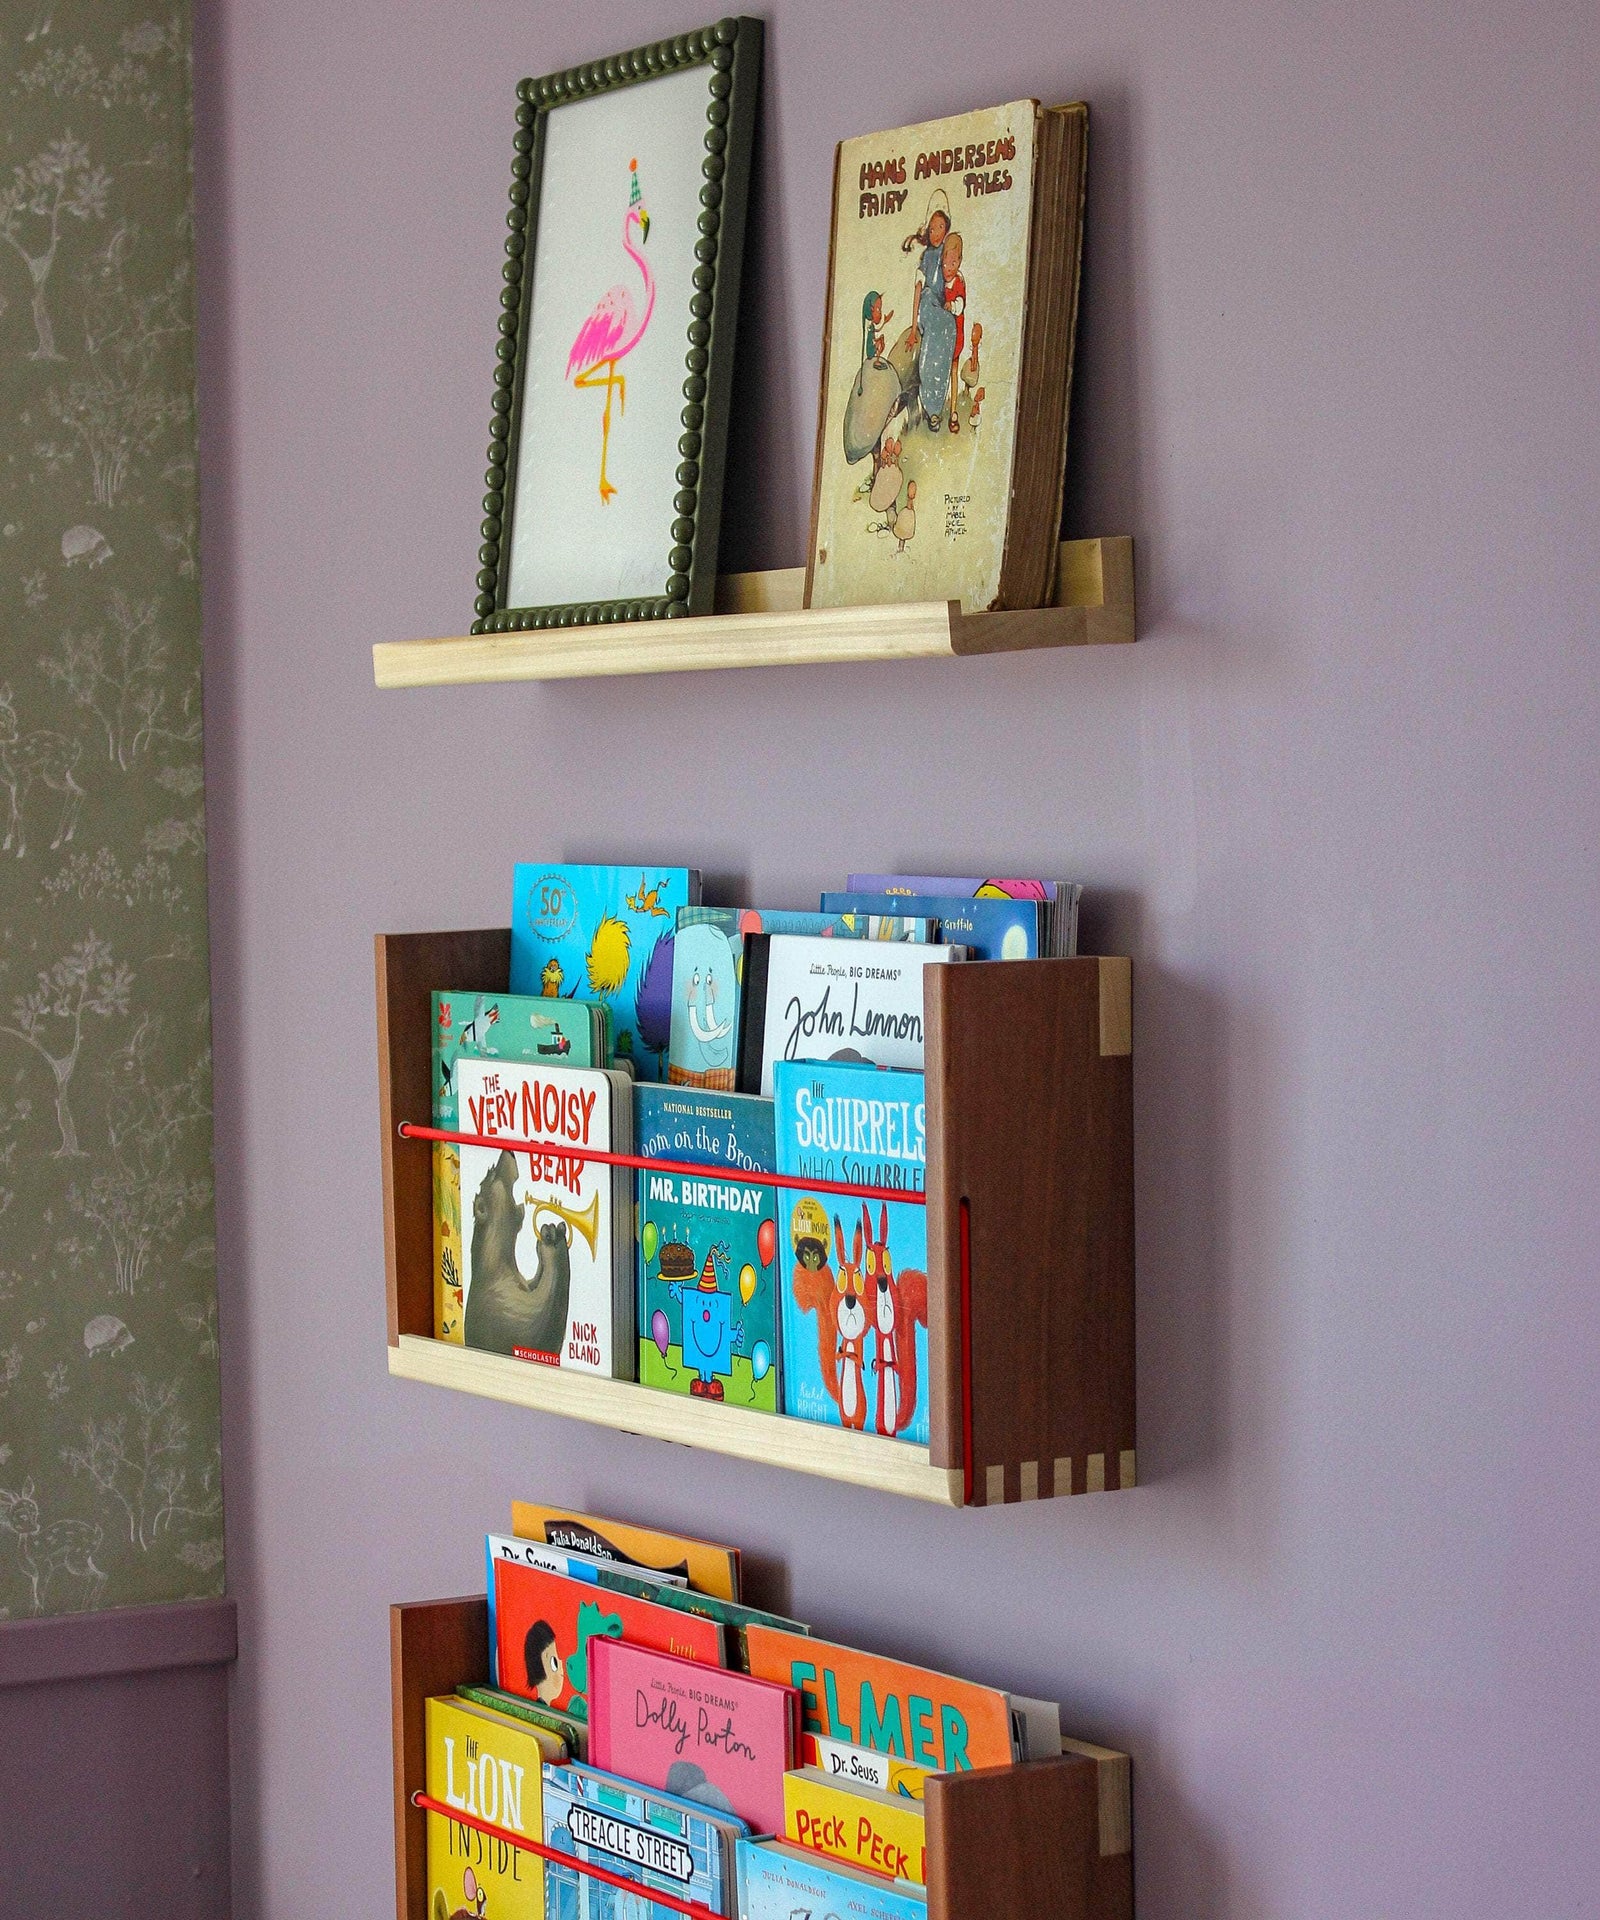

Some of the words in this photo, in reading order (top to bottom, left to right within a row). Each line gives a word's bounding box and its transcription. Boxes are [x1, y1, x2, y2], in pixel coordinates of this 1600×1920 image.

[859, 156, 907, 190] HANS
[963, 169, 1013, 198] TALES
[859, 189, 908, 219] FAIRY
[809, 963, 826, 975] Little
[849, 966, 863, 978] BIG
[784, 985, 845, 1060] John
[849, 981, 923, 1043] Lennon
[482, 1074, 500, 1095] THE
[812, 1080, 825, 1099] THE
[468, 1089, 517, 1136] VERY
[522, 1080, 597, 1145] NOISY
[663, 1102, 694, 1116] NATIONAL
[695, 1106, 732, 1120] BESTSELLER
[674, 1130, 693, 1150] on
[695, 1125, 720, 1155] the
[528, 1139, 585, 1196] BEAR
[799, 1154, 835, 1183] WHO
[649, 1176, 679, 1204] MR.
[681, 1181, 763, 1215] BIRTHDAY
[572, 1321, 598, 1344] NICK
[519, 1350, 560, 1365] SCHOLASTIC
[568, 1342, 601, 1366] BLAND
[550, 1529, 571, 1546] Julia
[570, 1531, 613, 1560] Donaldson
[688, 1688, 703, 1701] BIG
[636, 1689, 691, 1755] Dolly
[697, 1707, 756, 1761] Parton
[790, 1660, 974, 1774] ELMER
[466, 1735, 479, 1760] THE
[831, 1753, 848, 1775] Dr.
[850, 1755, 879, 1784] Seuss
[449, 1818, 522, 1882] INSIDE
[575, 1809, 631, 1855] TREACLE
[636, 1832, 686, 1876] STREET
[796, 1809, 847, 1850] PECK
[857, 1816, 909, 1880] PECK
[761, 1870, 784, 1884] JULIA
[786, 1876, 827, 1898] DONALDSON
[847, 1900, 867, 1914] AXEL
